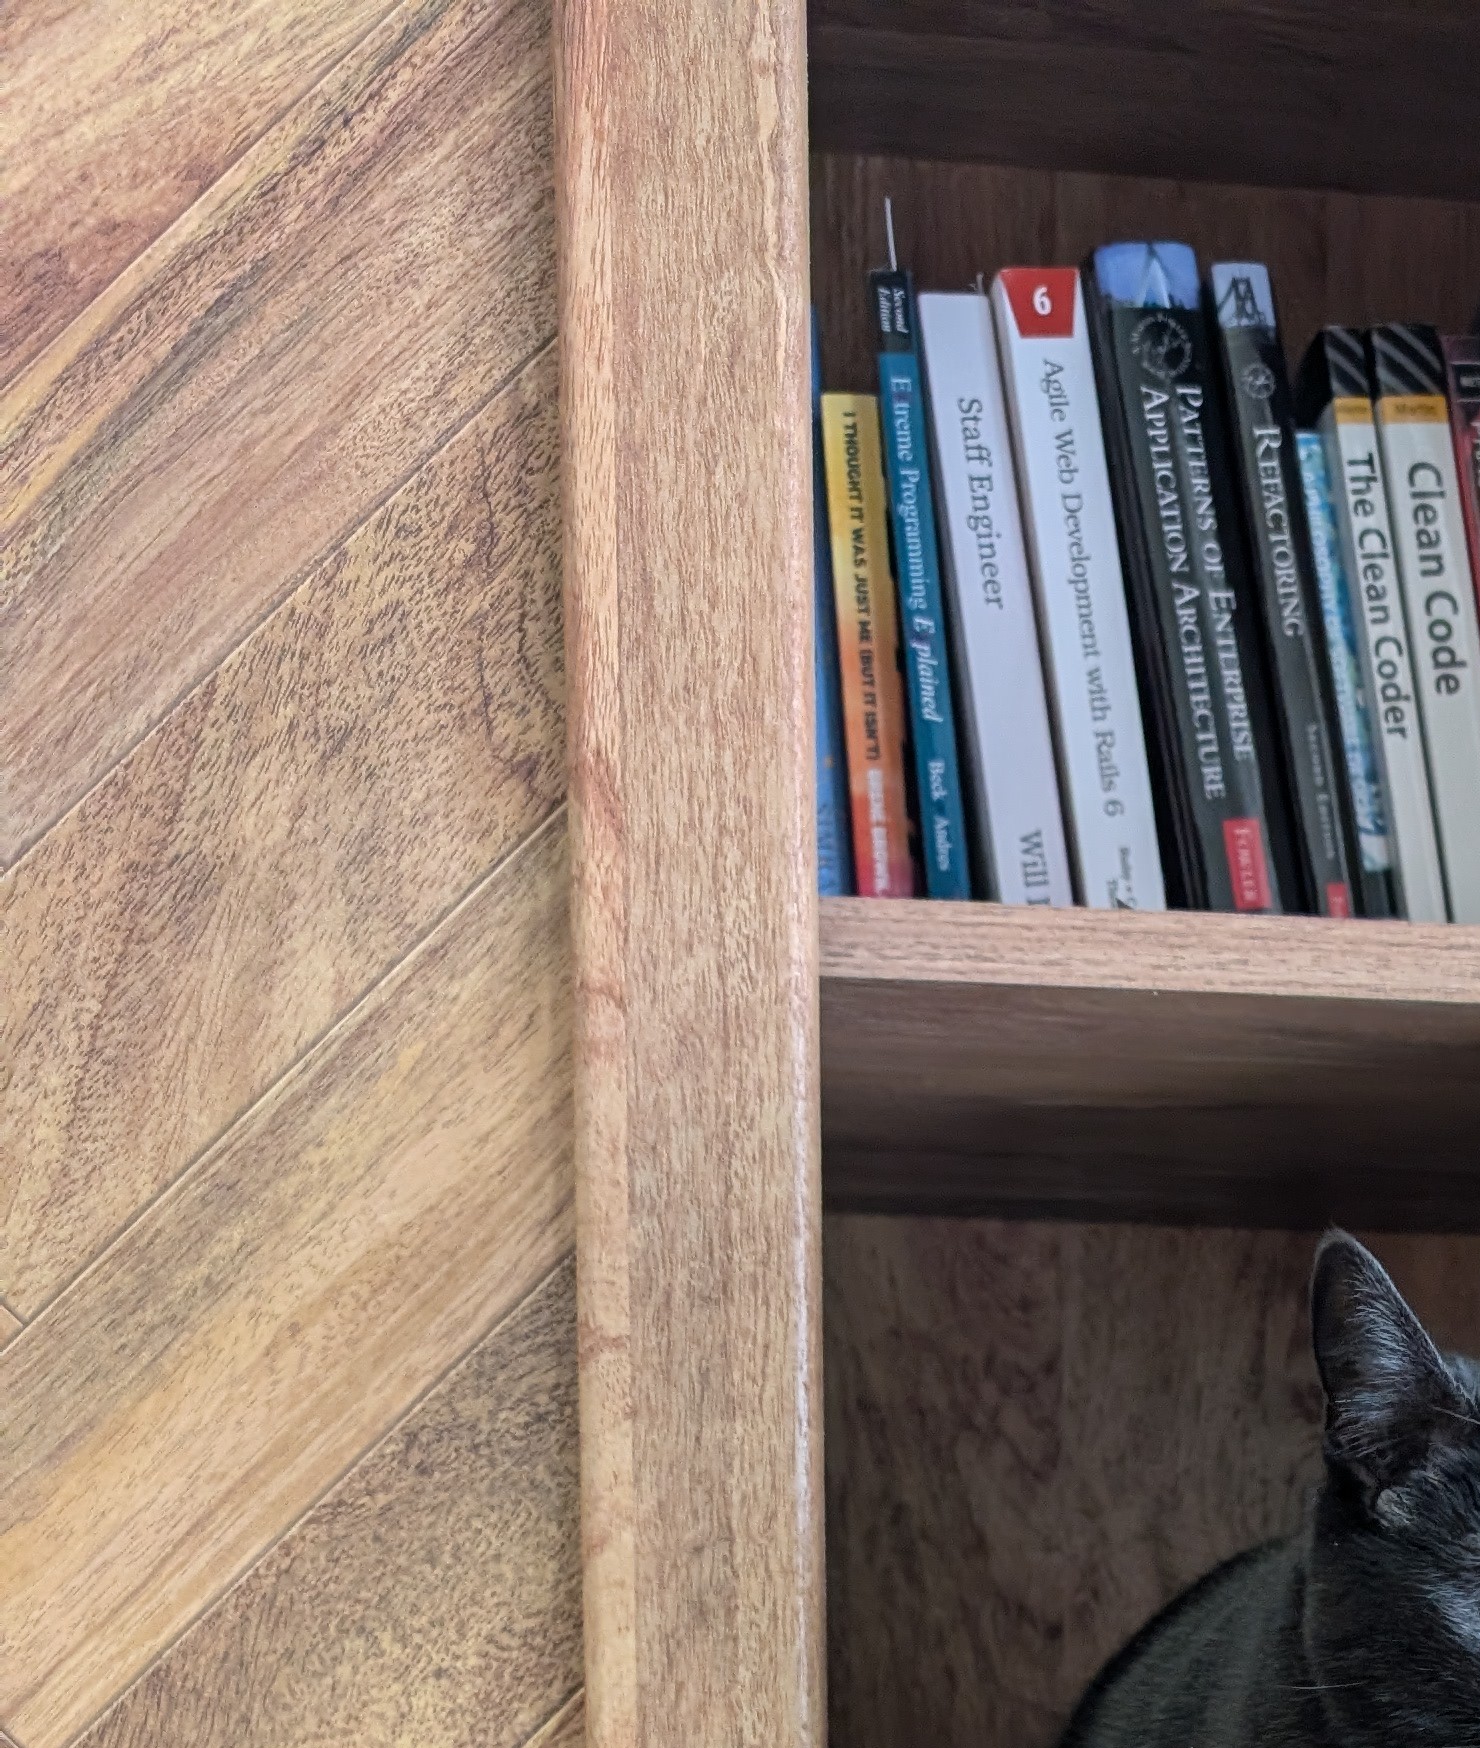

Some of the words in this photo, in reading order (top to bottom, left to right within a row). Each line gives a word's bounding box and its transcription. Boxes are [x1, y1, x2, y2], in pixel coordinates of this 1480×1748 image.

[891, 287, 909, 333] Second
[1032, 284, 1053, 316] 6
[1040, 358, 1070, 423] Agile
[843, 422, 862, 503] THOUGHT
[957, 397, 993, 468] Staff
[1054, 428, 1079, 484] Web
[1176, 384, 1217, 531] PATTERNS
[850, 507, 864, 523] IT
[1347, 452, 1377, 518] The
[853, 528, 867, 567] WAS
[897, 468, 928, 611] Programming
[966, 473, 1004, 611] Engineer
[1252, 427, 1302, 637] REFACTORING
[1408, 461, 1446, 577] Clean
[1061, 493, 1101, 658] Development
[1140, 385, 1190, 573] APPLICATION
[1171, 581, 1226, 800] ARCHITECTURE
[1202, 543, 1226, 579] OF
[1359, 528, 1390, 625] Clean
[855, 574, 870, 616] JUST
[858, 620, 872, 642] ME
[1425, 590, 1467, 695] Code
[864, 692, 877, 707] IT
[1086, 666, 1111, 722] with
[1208, 588, 1253, 762] ENTERPRISE
[1374, 636, 1411, 739] Coder
[928, 759, 947, 801] Beck
[1094, 729, 1120, 793] Rails
[1103, 799, 1125, 817] 6
[1019, 828, 1049, 888] Will
